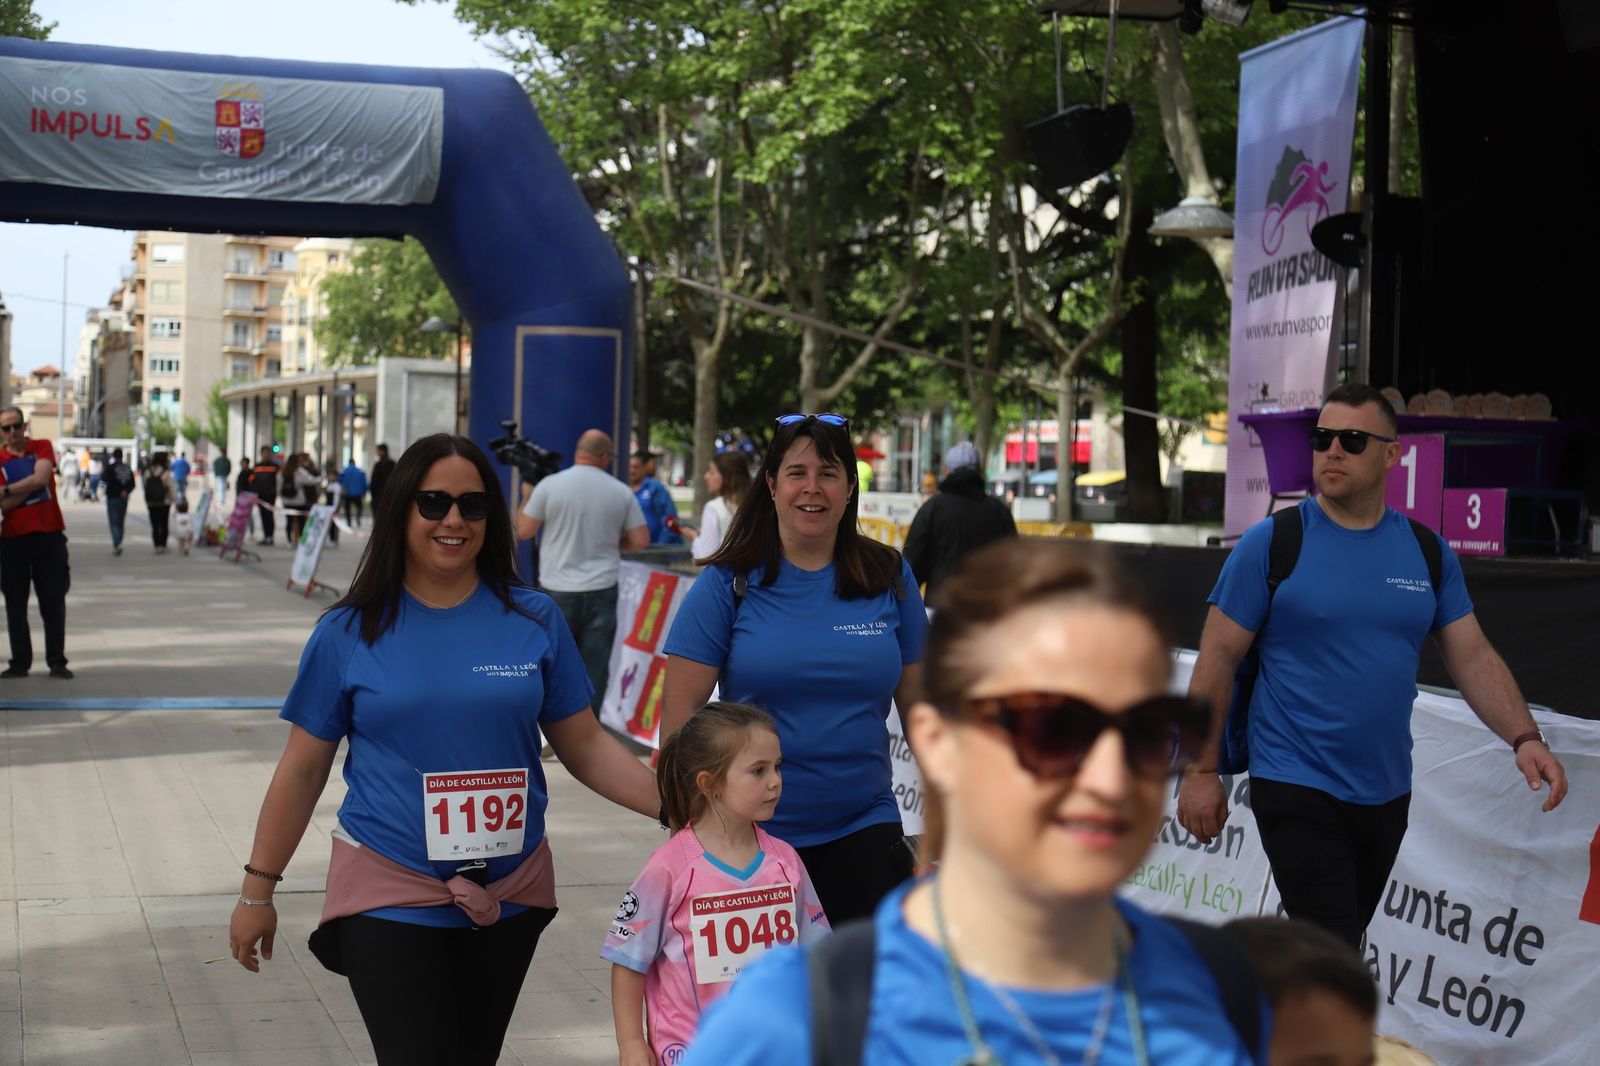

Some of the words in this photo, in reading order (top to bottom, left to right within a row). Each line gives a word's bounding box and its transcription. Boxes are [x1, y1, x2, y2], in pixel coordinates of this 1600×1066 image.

[31, 86, 87, 106] NOS
[31, 107, 177, 145] IMPULSA
[272, 140, 345, 162] Junta
[353, 143, 385, 164] de
[198, 161, 290, 186] Castilla
[299, 171, 313, 186] y
[321, 168, 384, 190] León
[1401, 444, 1417, 510] 1
[1466, 493, 1482, 530] 3
[833, 623, 867, 631] CASTILLA
[472, 664, 511, 673] CASTILLA
[520, 662, 538, 671] LEÓN
[429, 778, 446, 789] DÍA
[447, 779, 459, 787] DE
[460, 777, 497, 786] CASTILLA
[503, 774, 523, 784] LEÓN
[432, 793, 525, 836] 1192
[695, 900, 712, 911] DÍA
[713, 899, 726, 909] DE
[727, 896, 763, 907] CASTILLA
[763, 894, 769, 902] Y
[769, 889, 790, 900] LEÓN
[699, 909, 795, 957] 1048
[1383, 879, 1473, 945] unta
[1483, 906, 1545, 967] de
[1386, 952, 1412, 1006] y
[1416, 953, 1526, 1039] León
